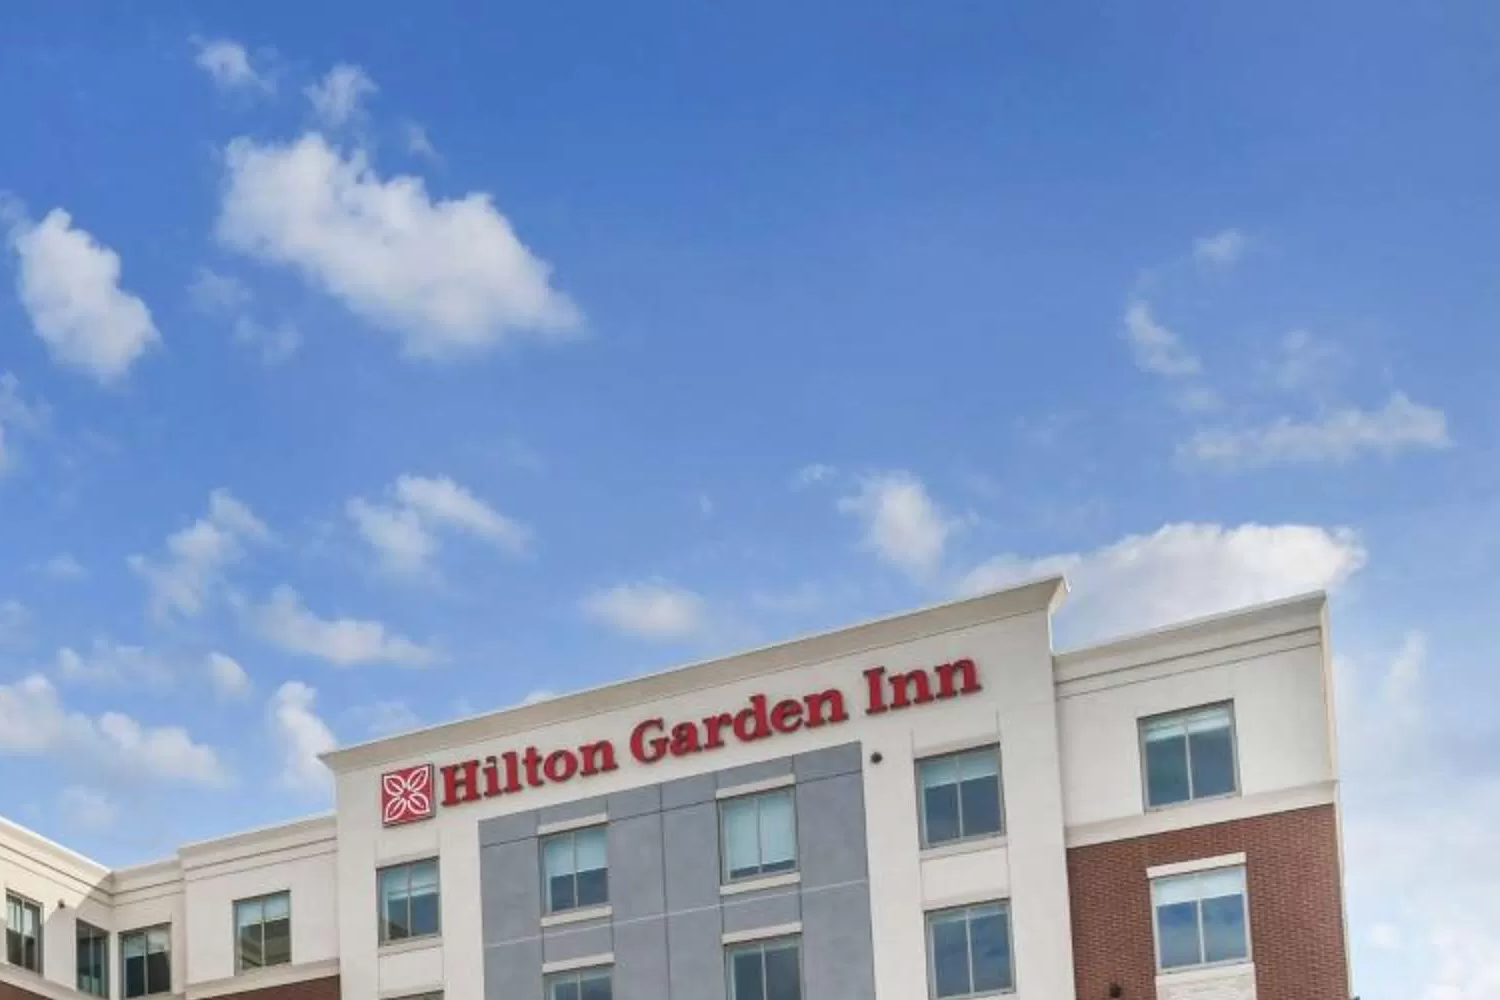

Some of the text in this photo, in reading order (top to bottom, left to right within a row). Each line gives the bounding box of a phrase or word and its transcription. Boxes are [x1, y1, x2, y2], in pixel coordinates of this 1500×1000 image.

[440, 656, 982, 806] Hilton Garden Inn
